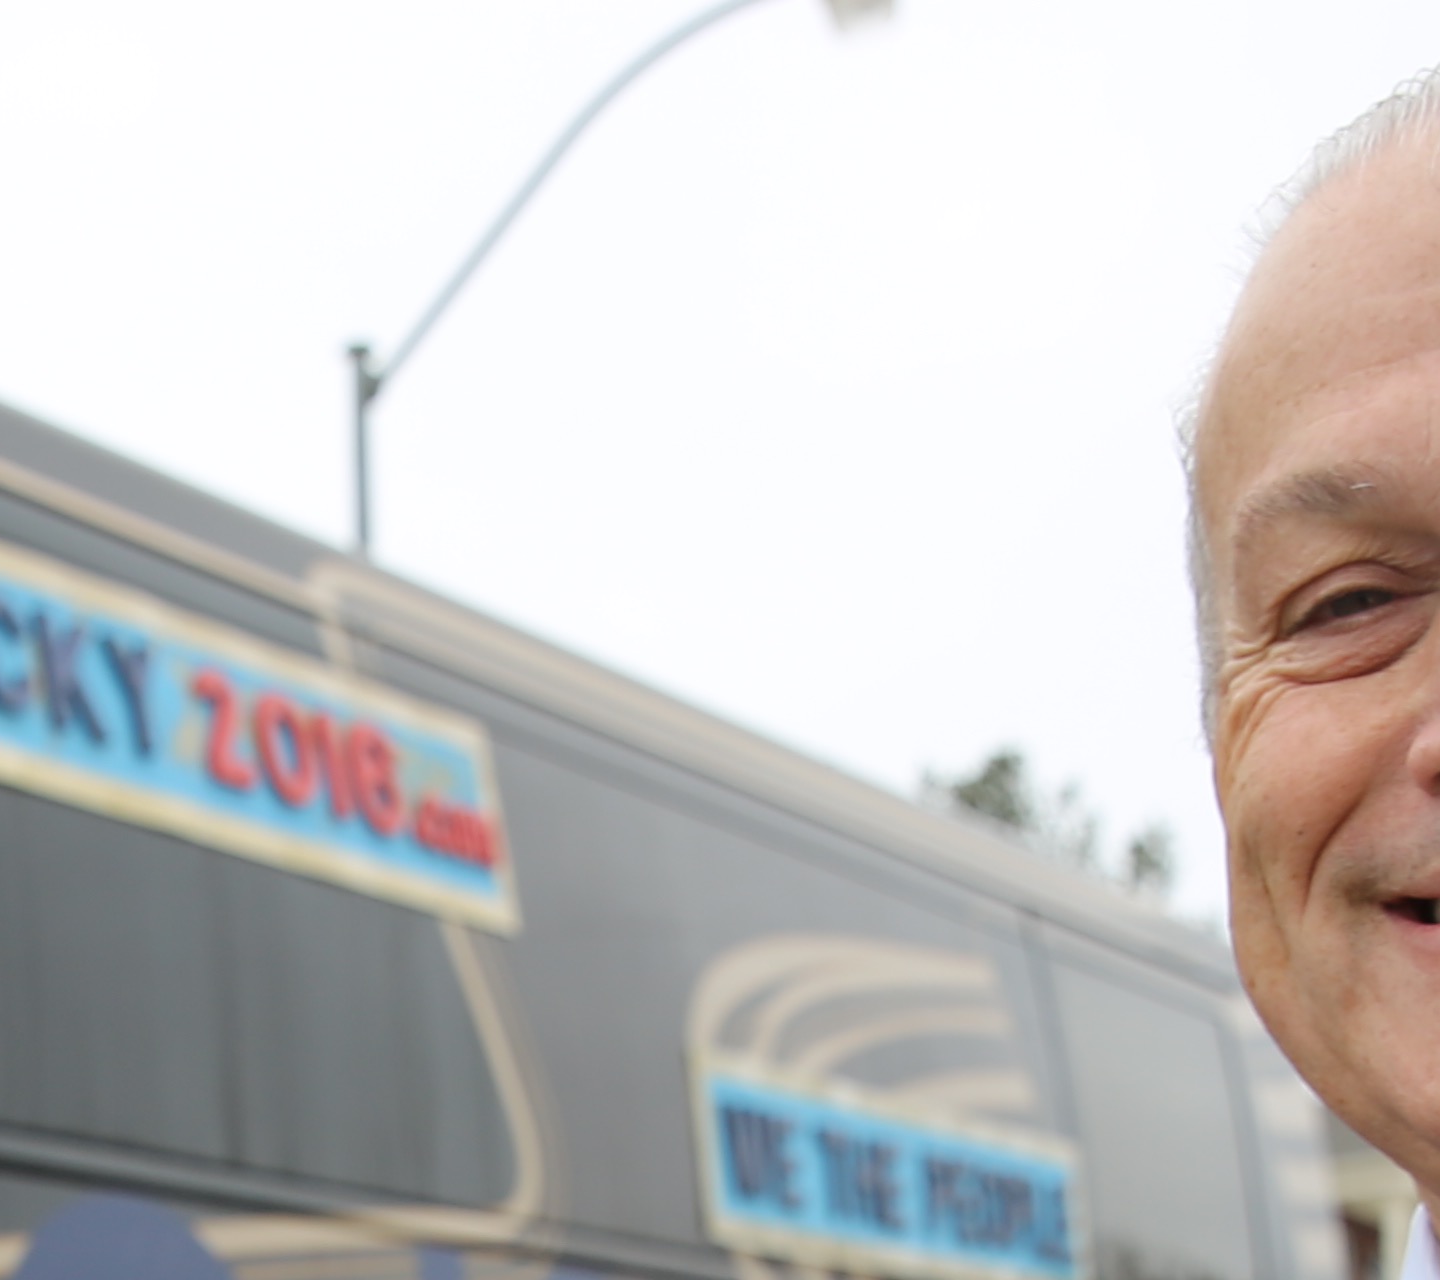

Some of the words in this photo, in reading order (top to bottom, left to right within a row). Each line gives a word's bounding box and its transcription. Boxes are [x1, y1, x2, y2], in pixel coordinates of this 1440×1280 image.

[722, 1105, 801, 1211] WE
[816, 1126, 905, 1234] THE
[924, 1155, 1074, 1268] PEOPLE
